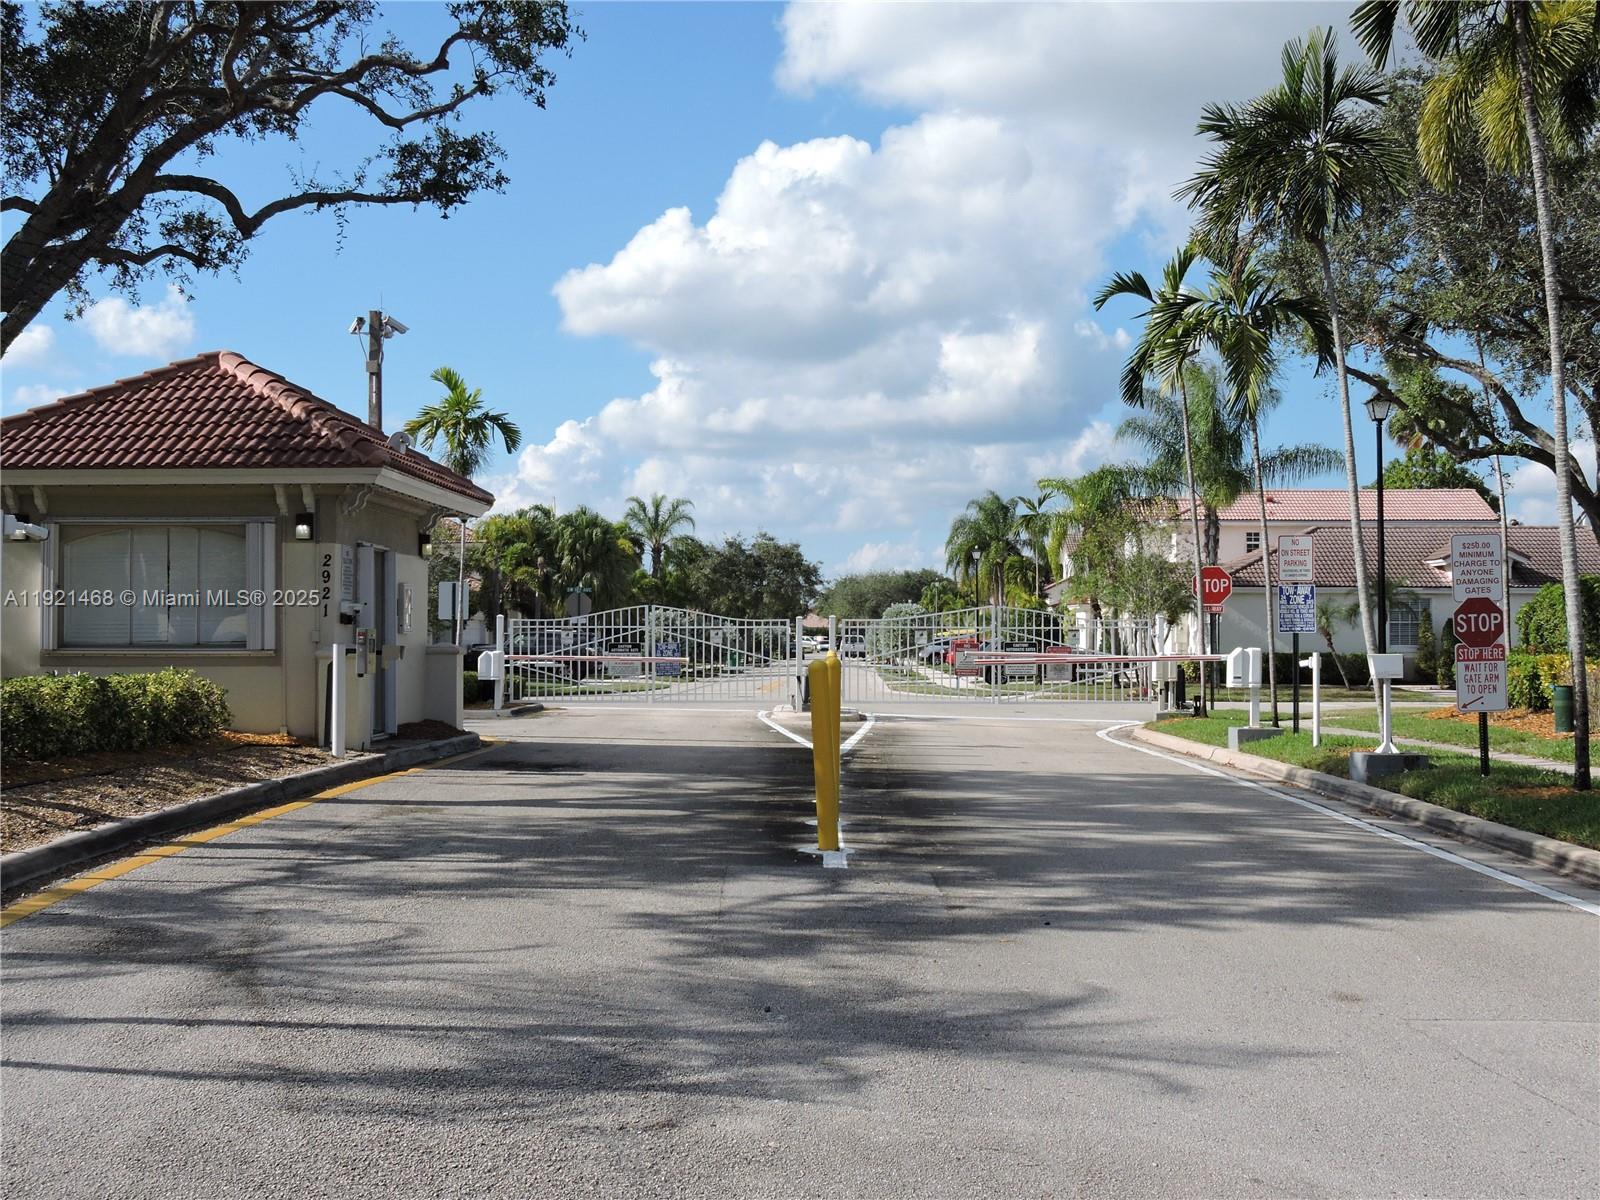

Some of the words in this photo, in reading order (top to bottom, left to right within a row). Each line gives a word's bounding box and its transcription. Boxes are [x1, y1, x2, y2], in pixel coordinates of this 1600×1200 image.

[1462, 541, 1491, 549] $250.00
[1453, 560, 1487, 568] CHARGE
[322, 554, 332, 617] 2921
[1195, 578, 1229, 593] TOP
[1456, 578, 1500, 586] DAMAGING
[1456, 613, 1501, 633] STOP
[1458, 648, 1480, 660] STOP
[1482, 648, 1504, 660] HERE
[1463, 663, 1482, 673] WAIT
[1484, 663, 1498, 673] FOR
[1463, 674, 1482, 683] GATE
[1485, 673, 1500, 683] ARM
[1467, 685, 1476, 695] TO
[1478, 684, 1497, 694] OPEN
